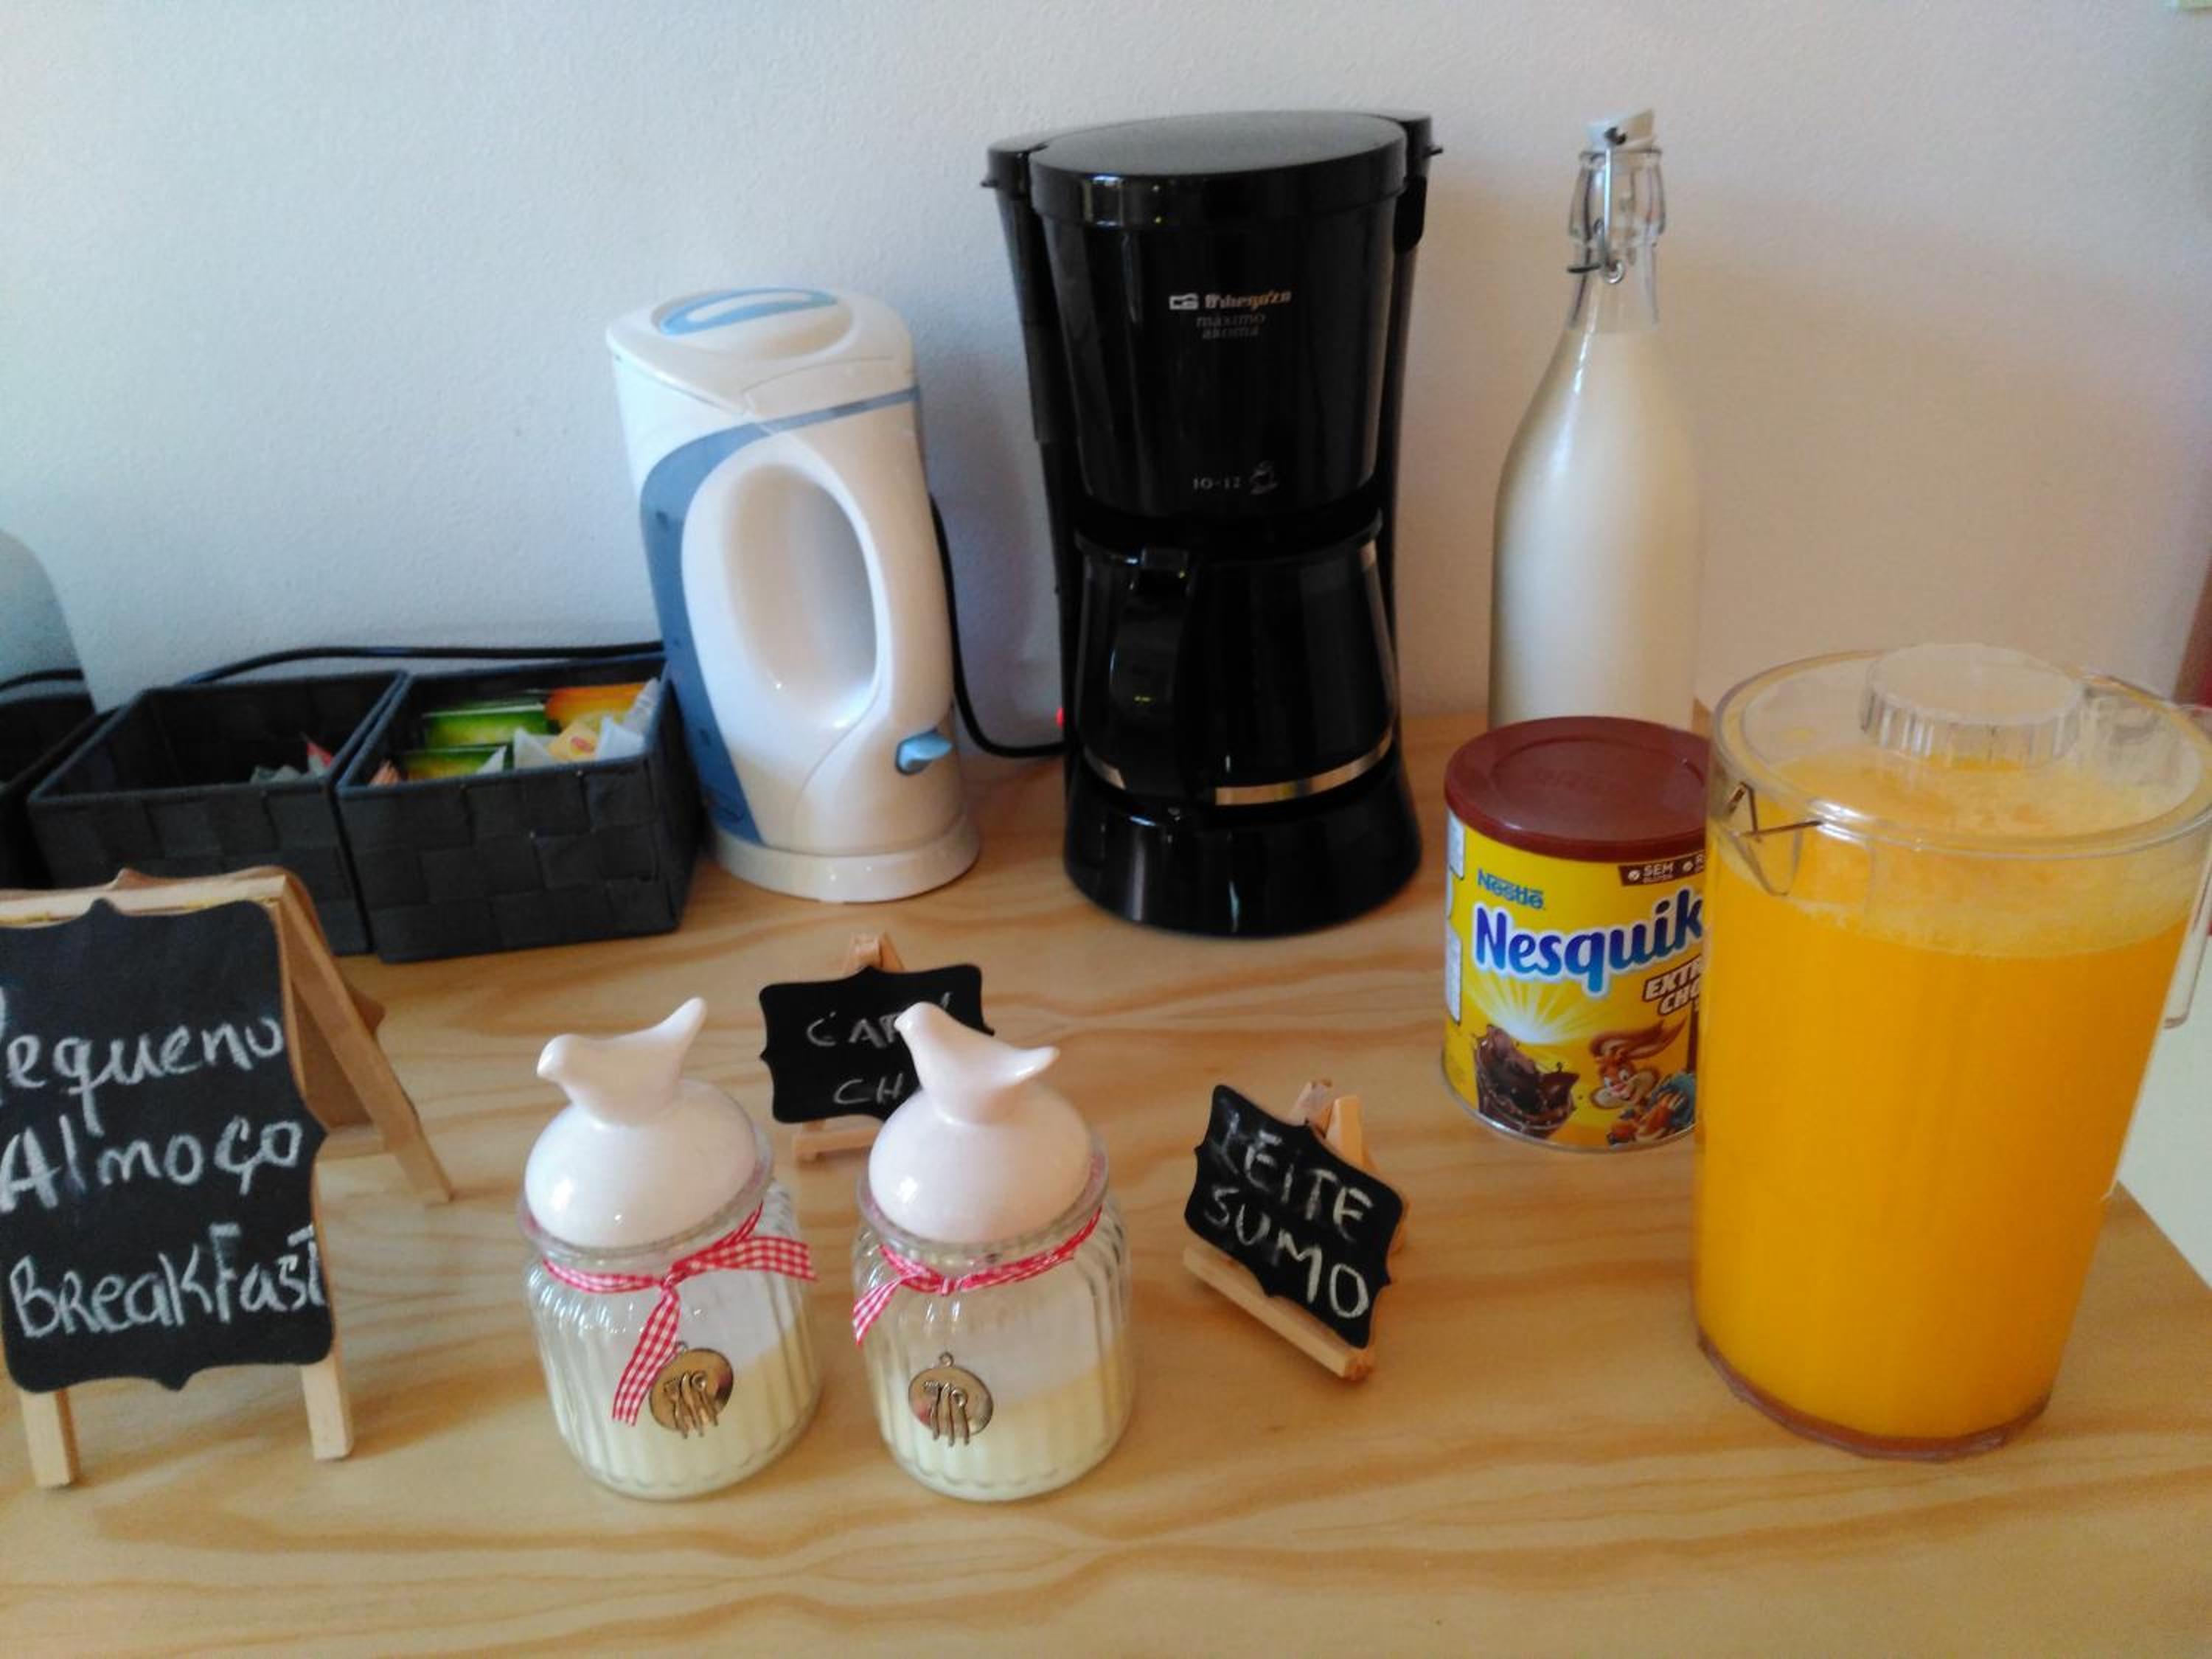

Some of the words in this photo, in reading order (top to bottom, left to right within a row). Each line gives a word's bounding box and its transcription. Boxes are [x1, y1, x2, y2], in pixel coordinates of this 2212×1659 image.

[1475, 888, 1703, 994] Nesquik
[0, 987, 285, 1136] equeno
[833, 1073, 904, 1105] CH
[0, 1115, 302, 1214] Almoço
[1205, 1184, 1369, 1318] SUMO
